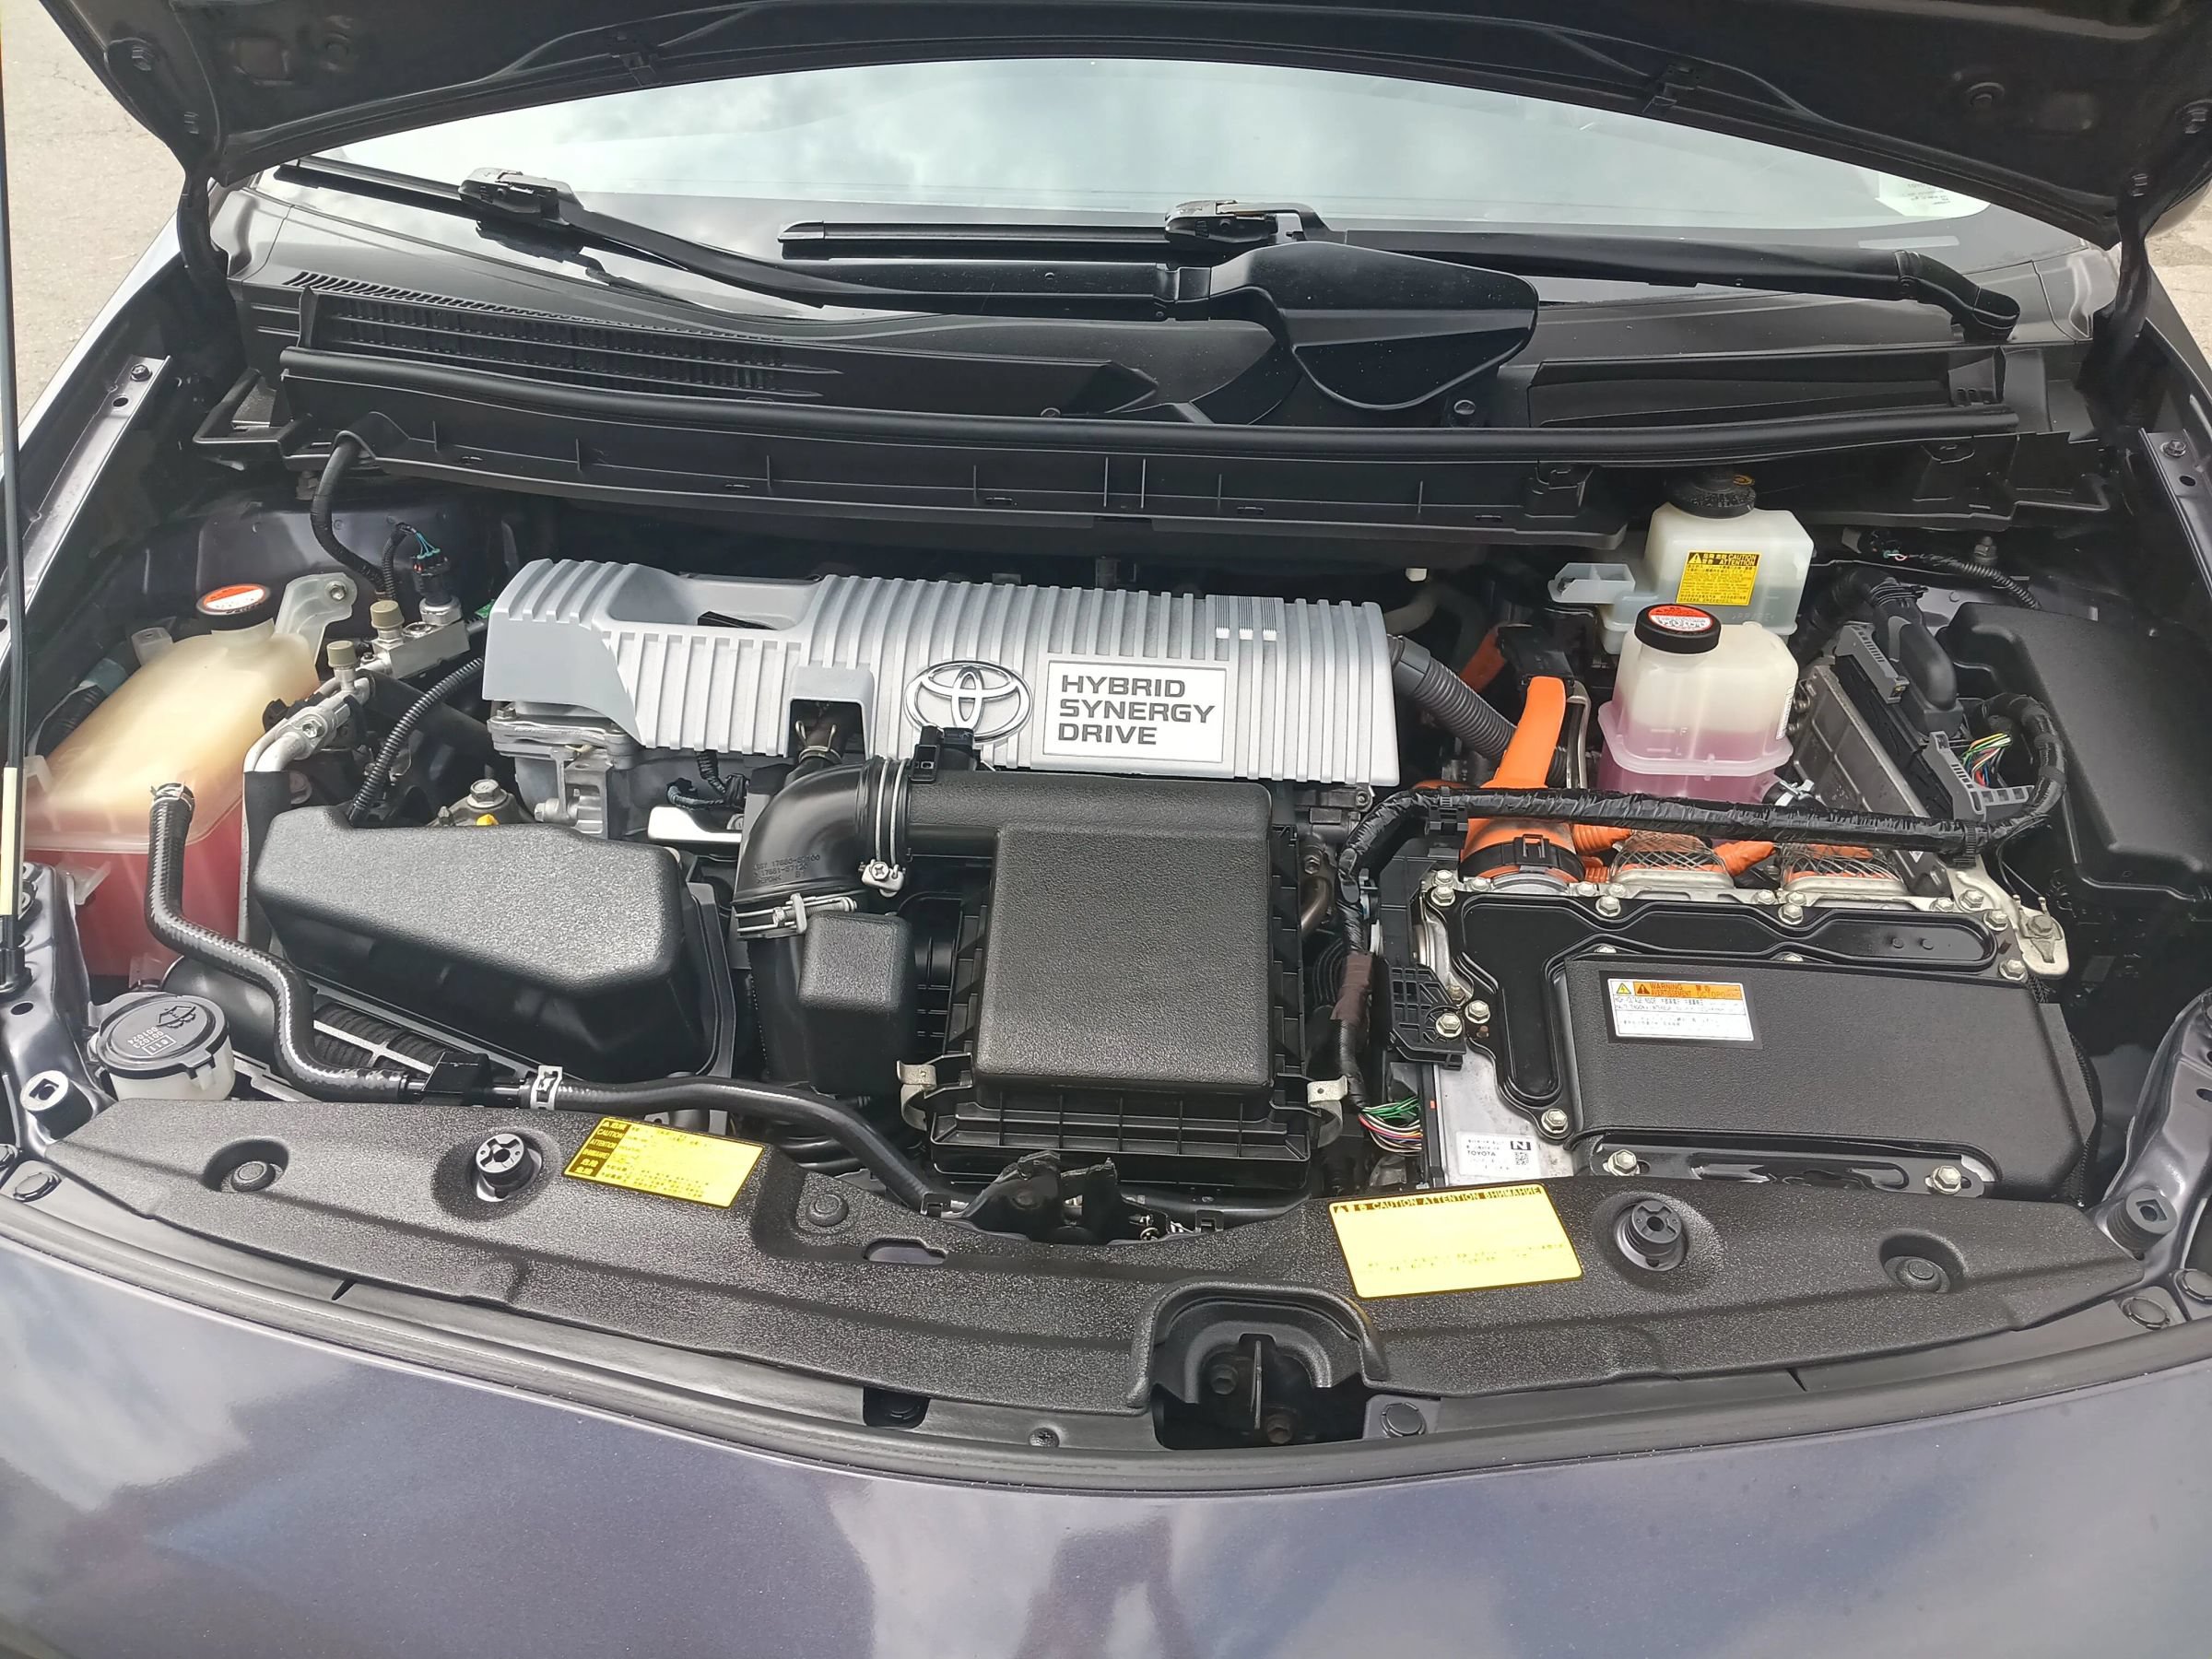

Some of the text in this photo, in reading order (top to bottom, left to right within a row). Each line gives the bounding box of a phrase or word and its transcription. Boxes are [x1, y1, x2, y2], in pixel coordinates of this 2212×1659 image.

[1061, 675, 1186, 698] HYBRID
[1059, 699, 1216, 724] SYNERGY
[1058, 723, 1158, 745] DRIVE
[1650, 982, 1682, 991] WARNING
[128, 1027, 159, 1044] 001024
[133, 1031, 164, 1048] 001023
[596, 1128, 625, 1139] CAUTION
[589, 1138, 618, 1149] ATTENTION
[1373, 1197, 1418, 1209] CAUTION
[1422, 1192, 1479, 1205] ATTENTION
[1484, 1186, 1540, 1200] ВНИМАНИЕ
